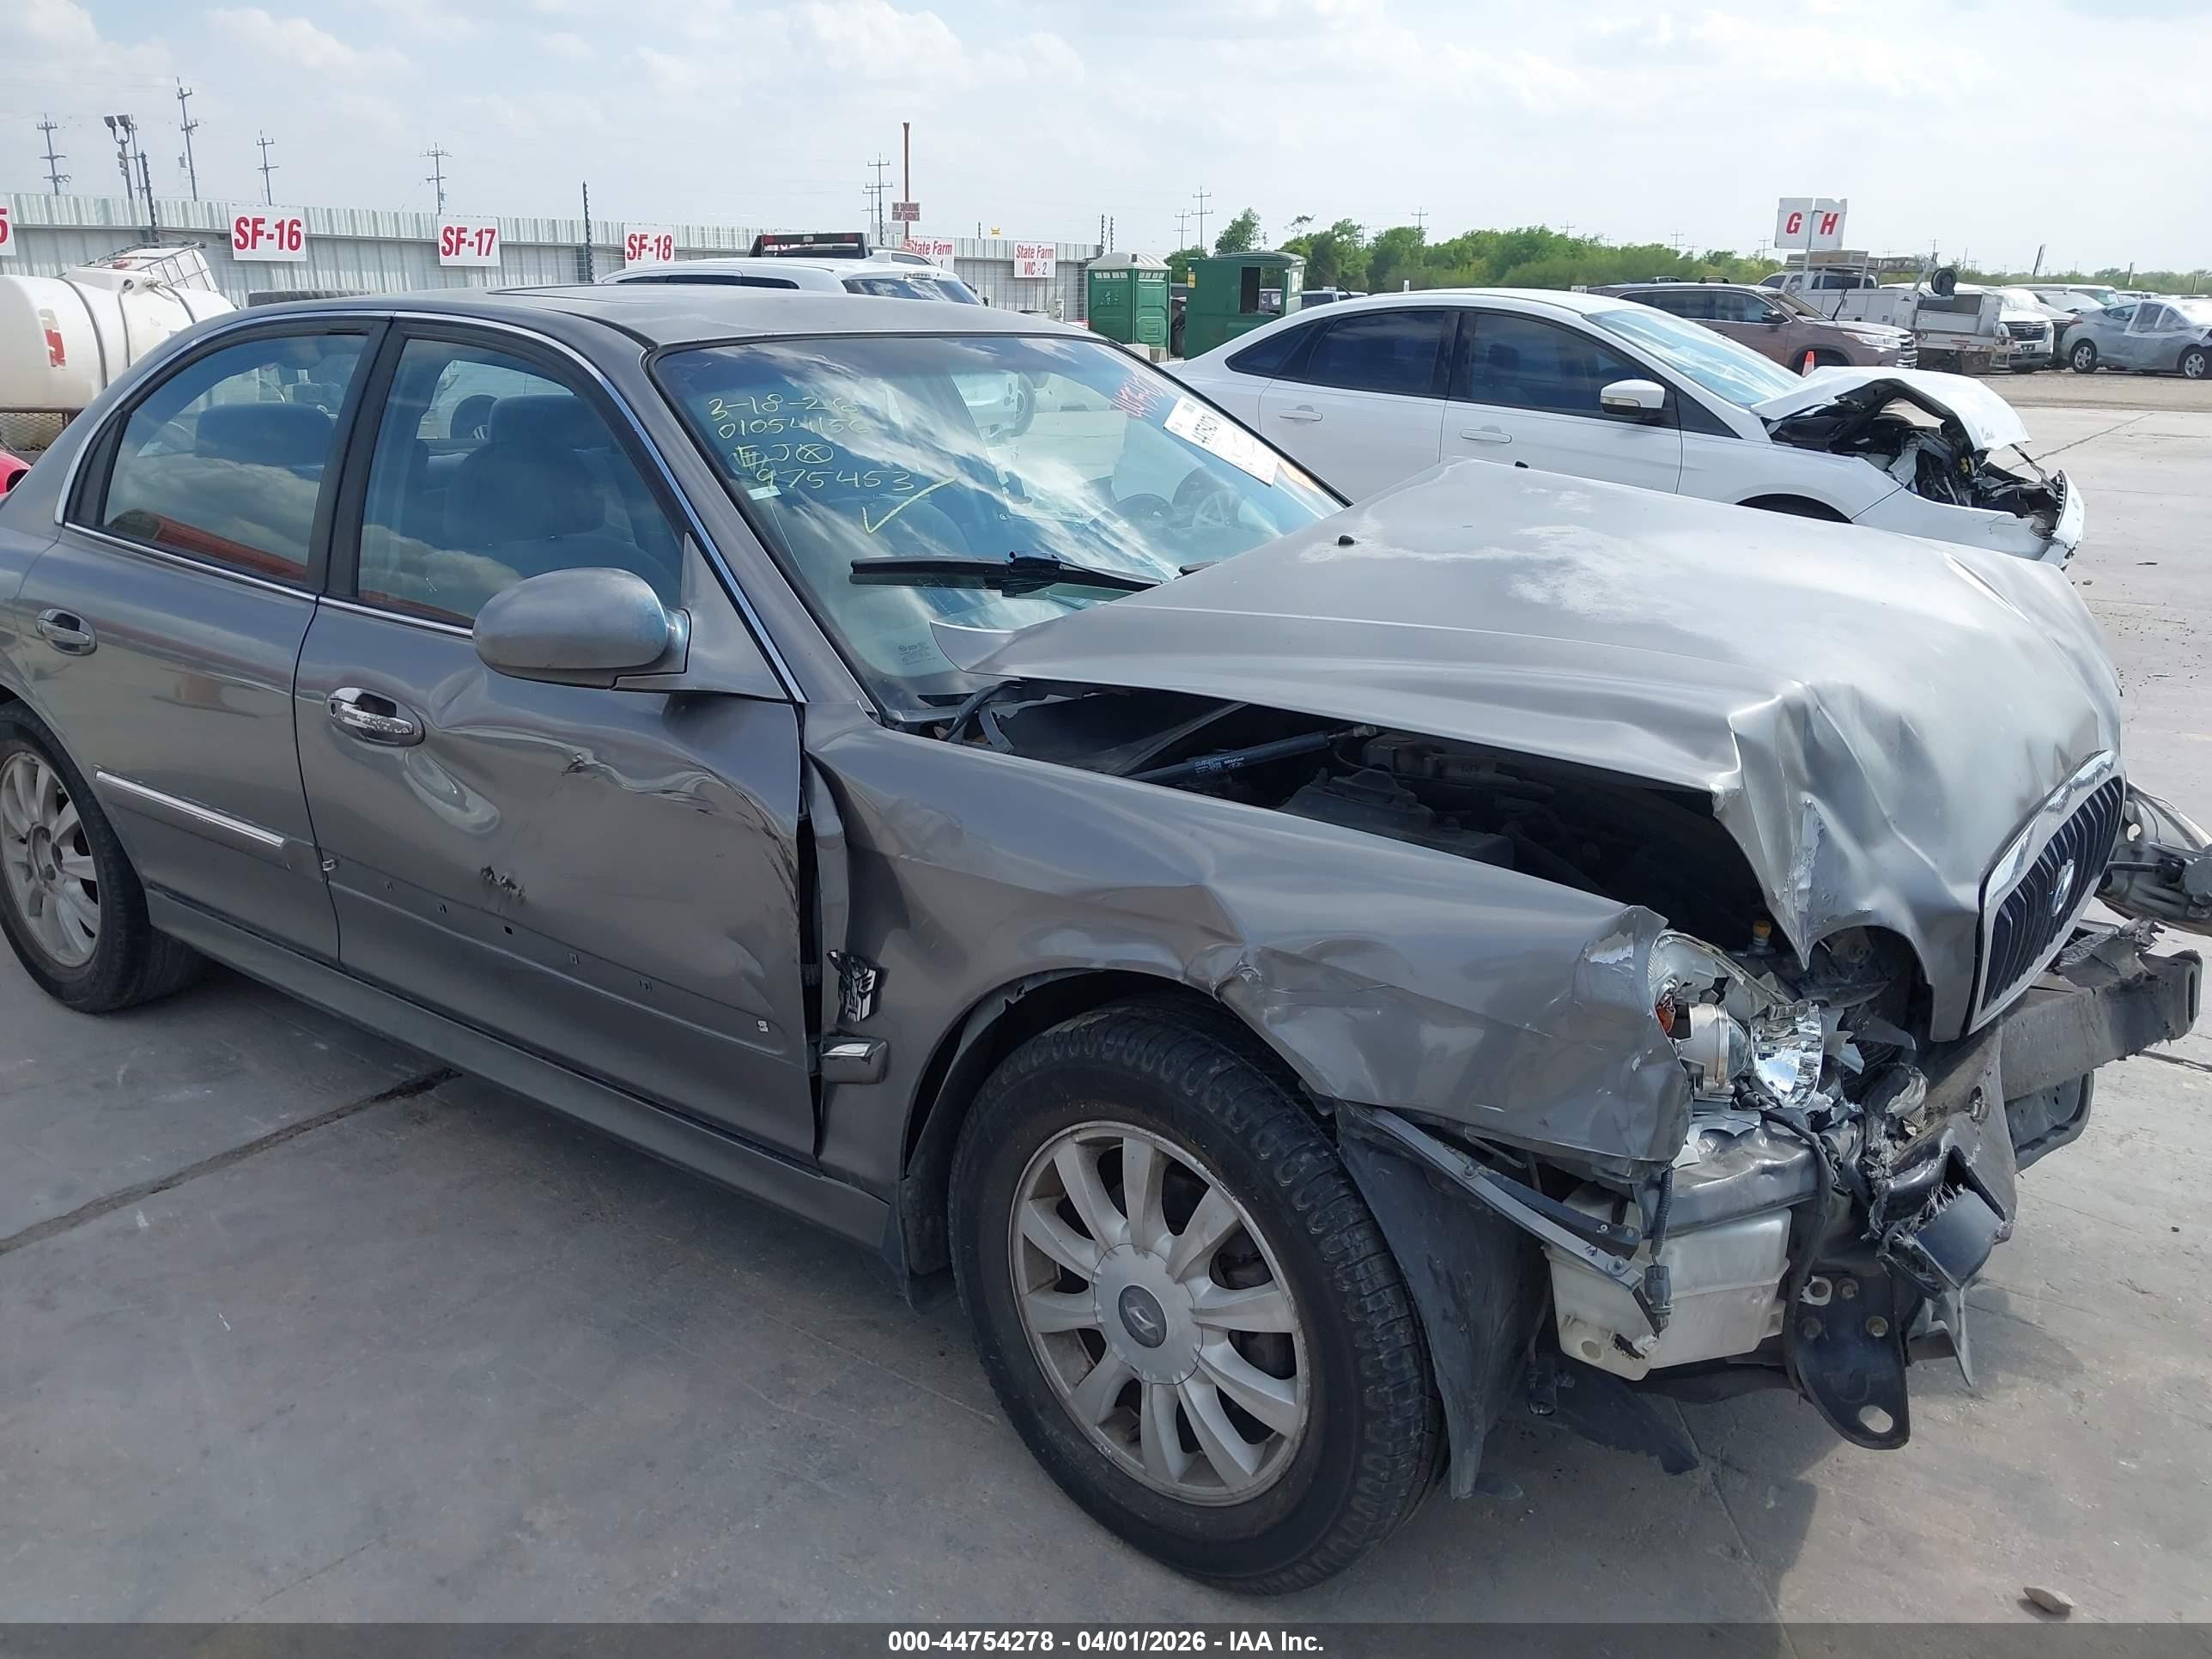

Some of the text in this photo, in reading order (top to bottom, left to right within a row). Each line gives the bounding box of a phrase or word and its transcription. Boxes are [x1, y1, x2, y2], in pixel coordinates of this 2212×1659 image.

[234, 216, 302, 251] SF-16
[1786, 212, 1802, 234] G
[1820, 213, 1838, 234] H
[441, 226, 496, 257] SF-17
[626, 233, 672, 261] SF-18
[933, 240, 952, 255] Farm
[1017, 245, 1054, 258] State Farm
[1024, 262, 1036, 275] VIC
[1042, 262, 1048, 275] 2
[708, 393, 858, 422] 3-18-26
[756, 469, 915, 491] 975453
